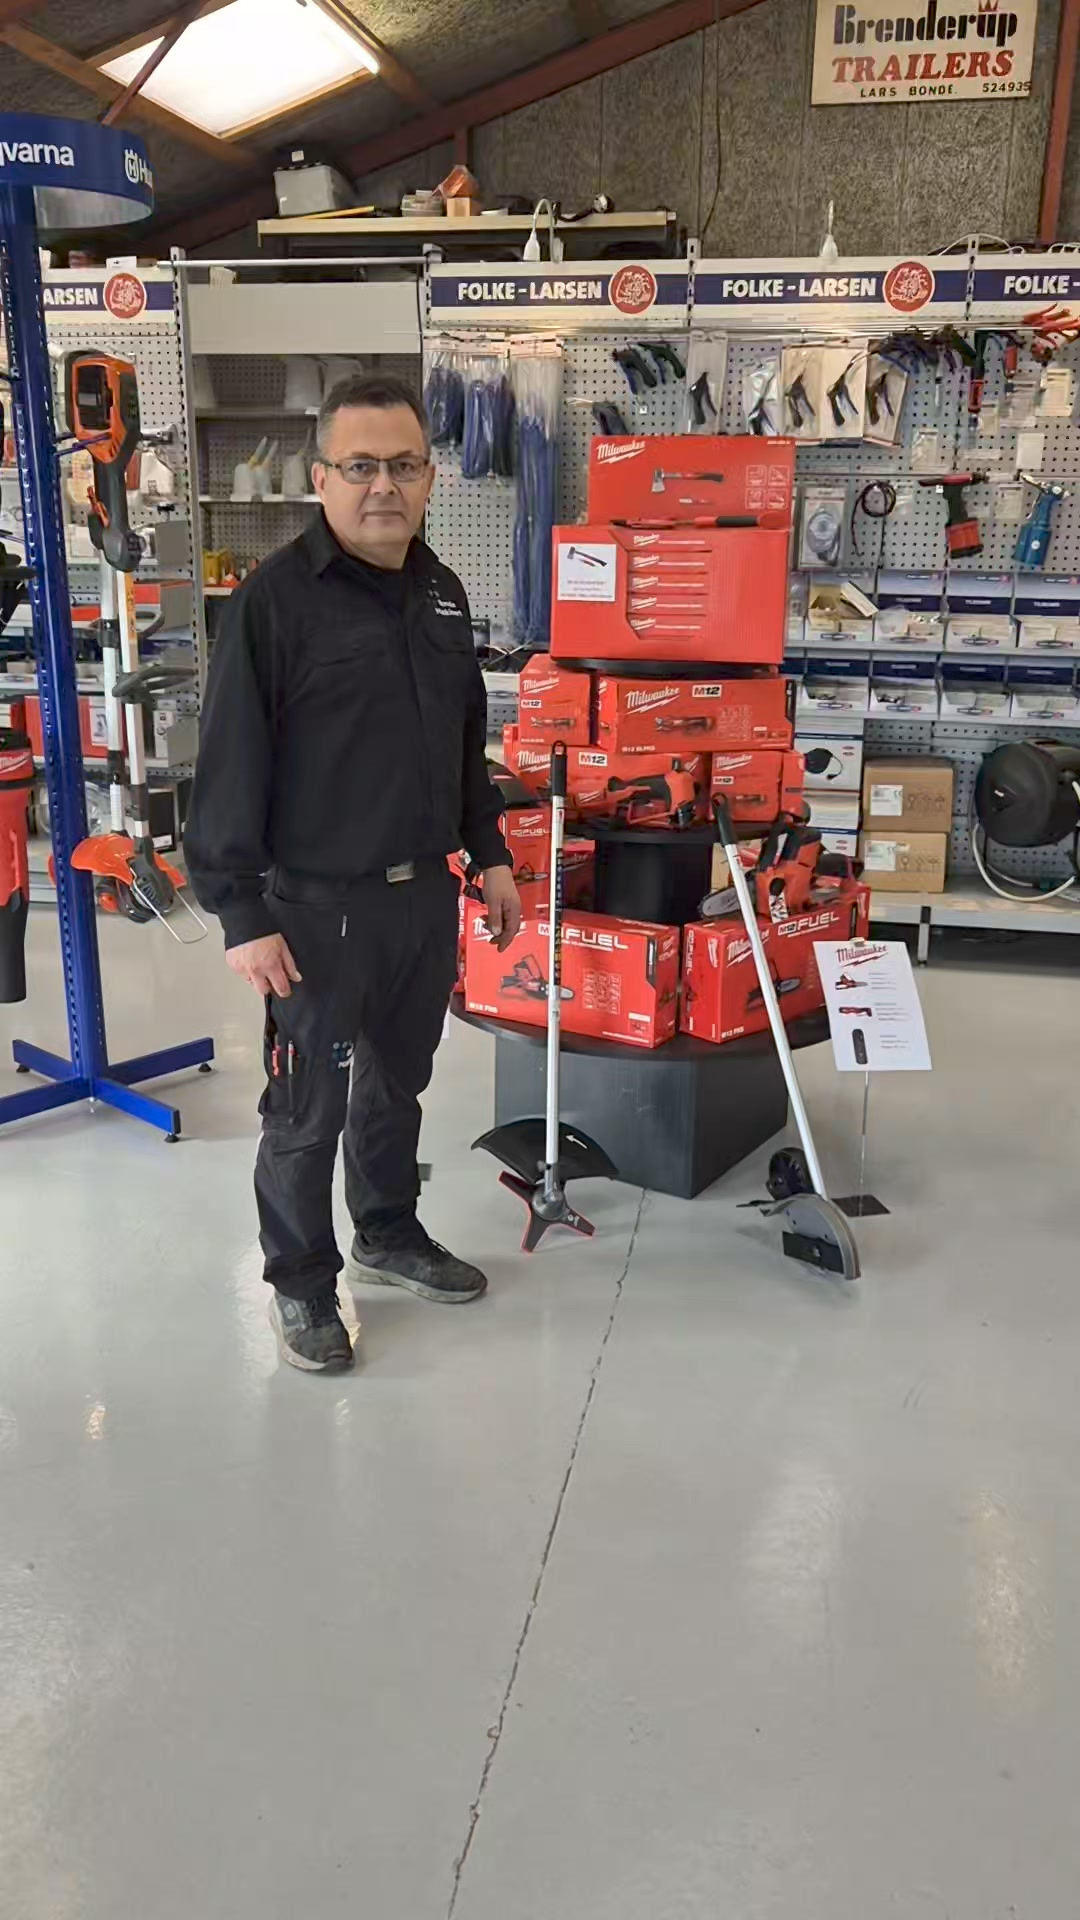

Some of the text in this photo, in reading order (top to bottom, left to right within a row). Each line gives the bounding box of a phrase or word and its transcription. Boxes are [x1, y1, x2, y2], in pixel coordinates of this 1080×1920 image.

[833, 0, 1018, 47] Brenderup
[832, 50, 1014, 83] TRAILERS
[860, 87, 897, 98] LARS
[982, 81, 1032, 93] 524935
[597, 441, 646, 460] Milwaukee
[625, 686, 680, 708] Milwaukee
[693, 685, 721, 697] M12
[580, 754, 606, 765] M12
[797, 912, 840, 931] FUEL
[567, 928, 628, 949] FUEL
[835, 945, 888, 963] Milwaukee
